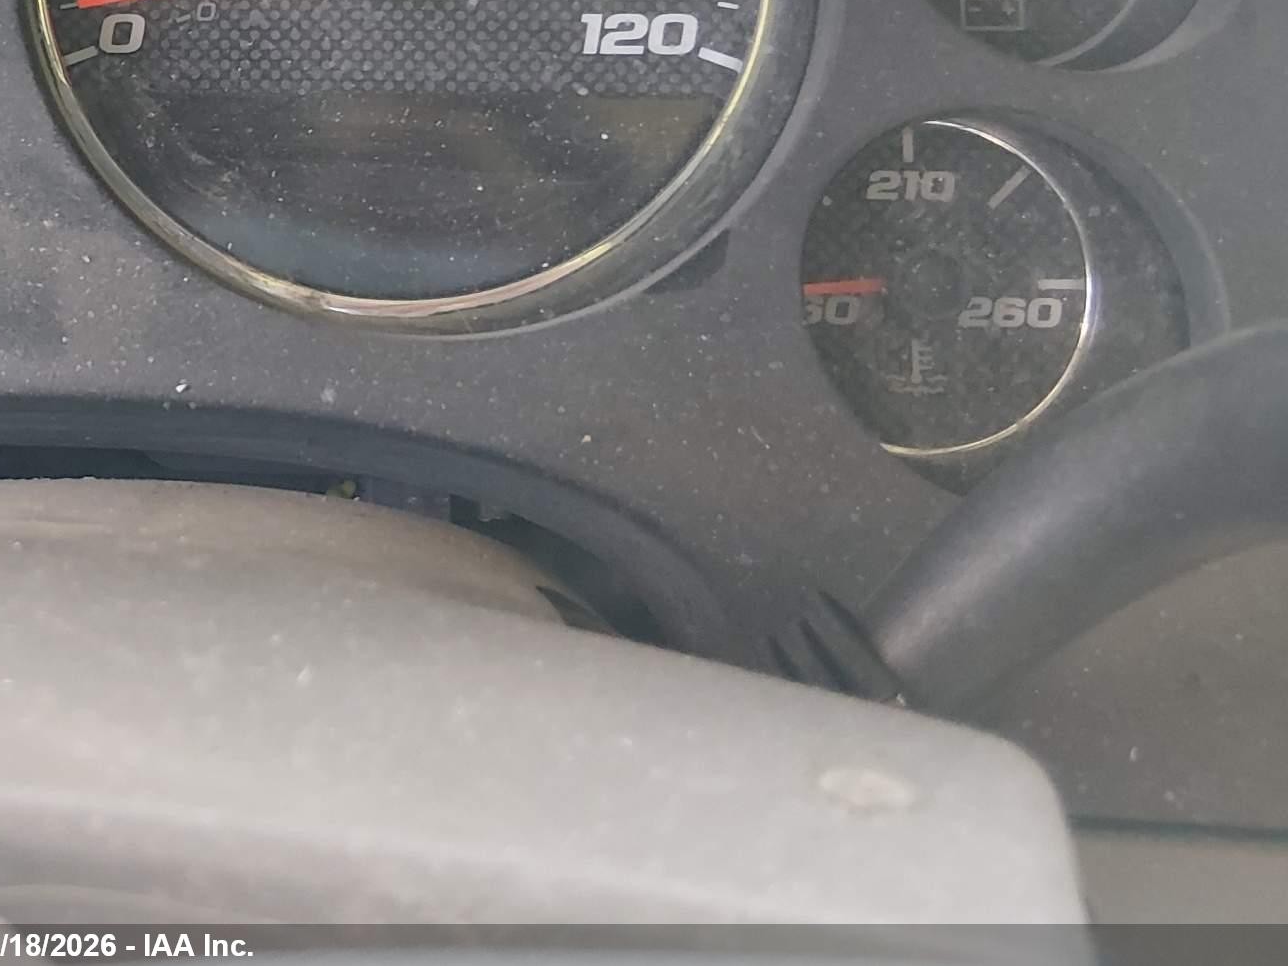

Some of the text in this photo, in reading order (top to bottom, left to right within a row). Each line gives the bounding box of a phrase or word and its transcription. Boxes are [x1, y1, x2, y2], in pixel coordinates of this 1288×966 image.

[99, 13, 146, 55] 0
[580, 13, 699, 56] 120
[866, 169, 956, 203] 210
[958, 296, 1063, 329] 260
